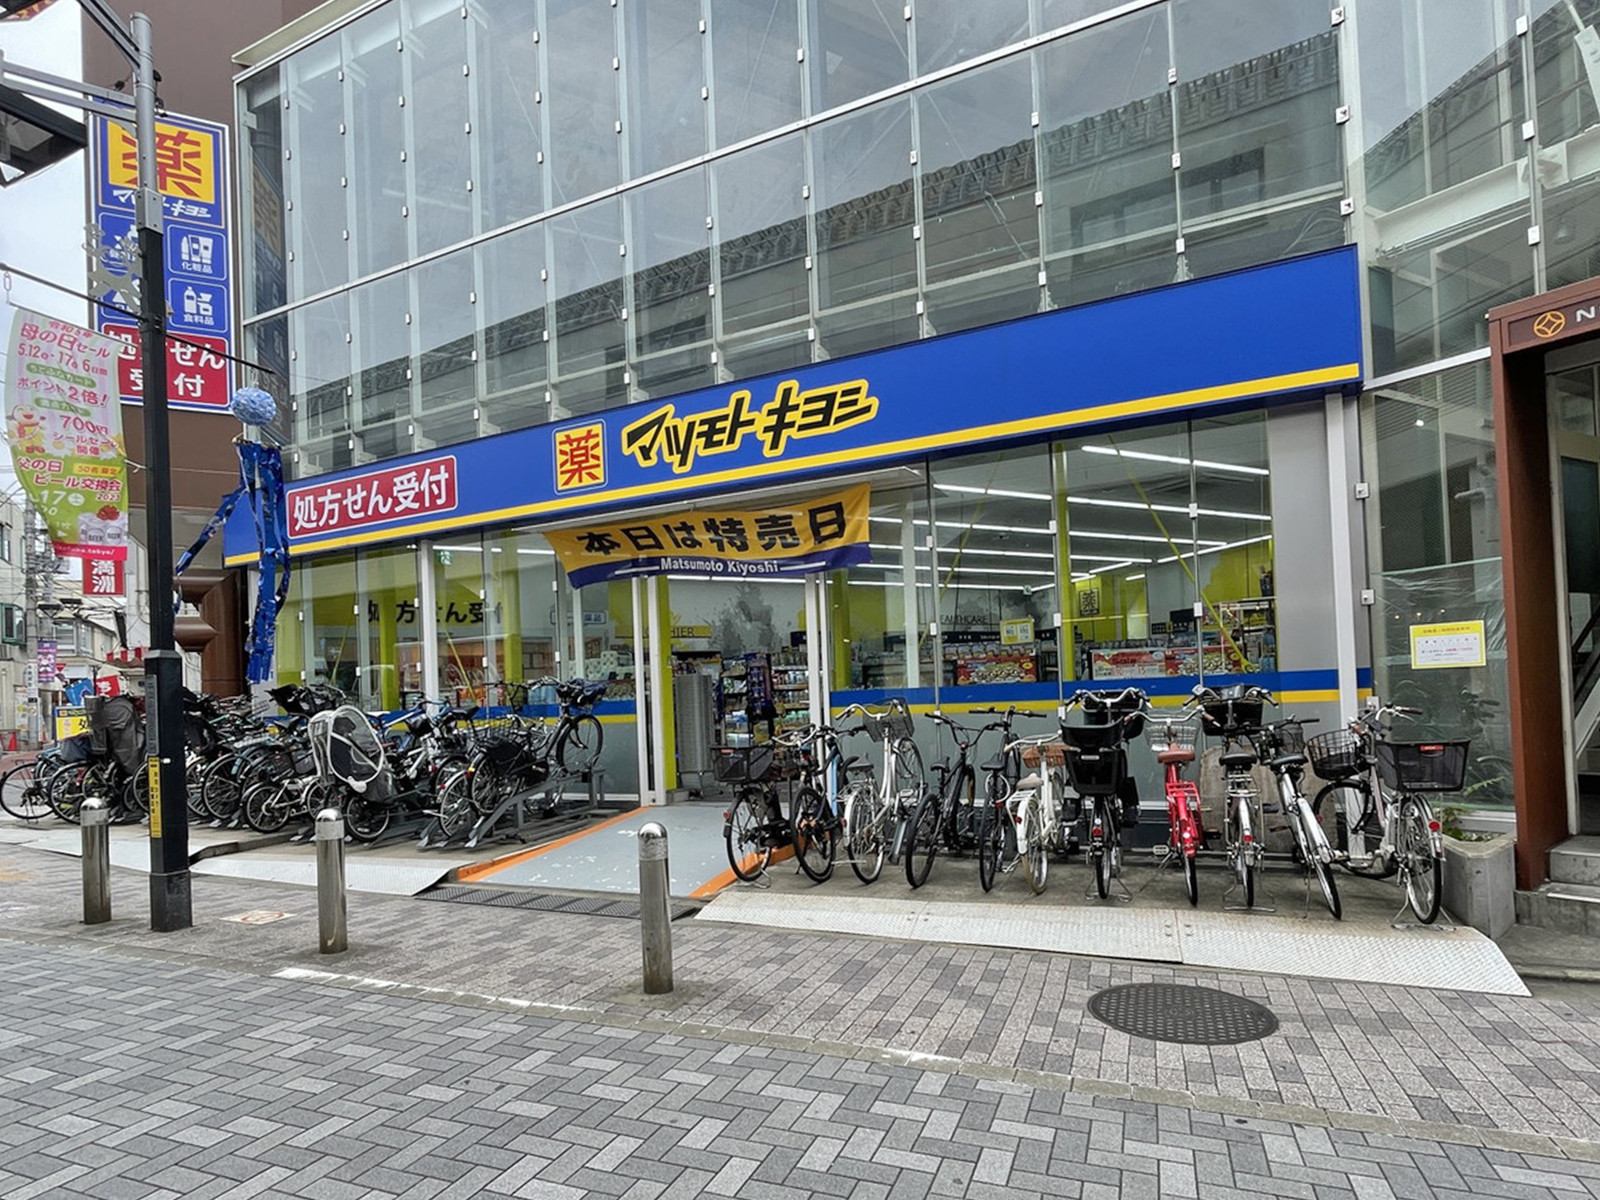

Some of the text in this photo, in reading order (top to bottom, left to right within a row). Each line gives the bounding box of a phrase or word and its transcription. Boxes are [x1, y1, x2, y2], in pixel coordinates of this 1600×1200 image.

[122, 131, 202, 198] 薬
[182, 261, 213, 274] 化粧品
[184, 313, 214, 326] 食料品
[1576, 305, 1600, 322] N
[21, 322, 110, 358] 母の日セール
[625, 385, 873, 468] マツモトキヨシ
[17, 457, 62, 473] 父の日
[558, 428, 602, 487] 薬
[34, 473, 121, 491] ビール交換会
[294, 465, 449, 531] 処方せん受付
[576, 501, 848, 557] 本日は特売日
[660, 557, 779, 574] Matsumoto Kiyoshi
[940, 615, 989, 624] EALTHCARE
